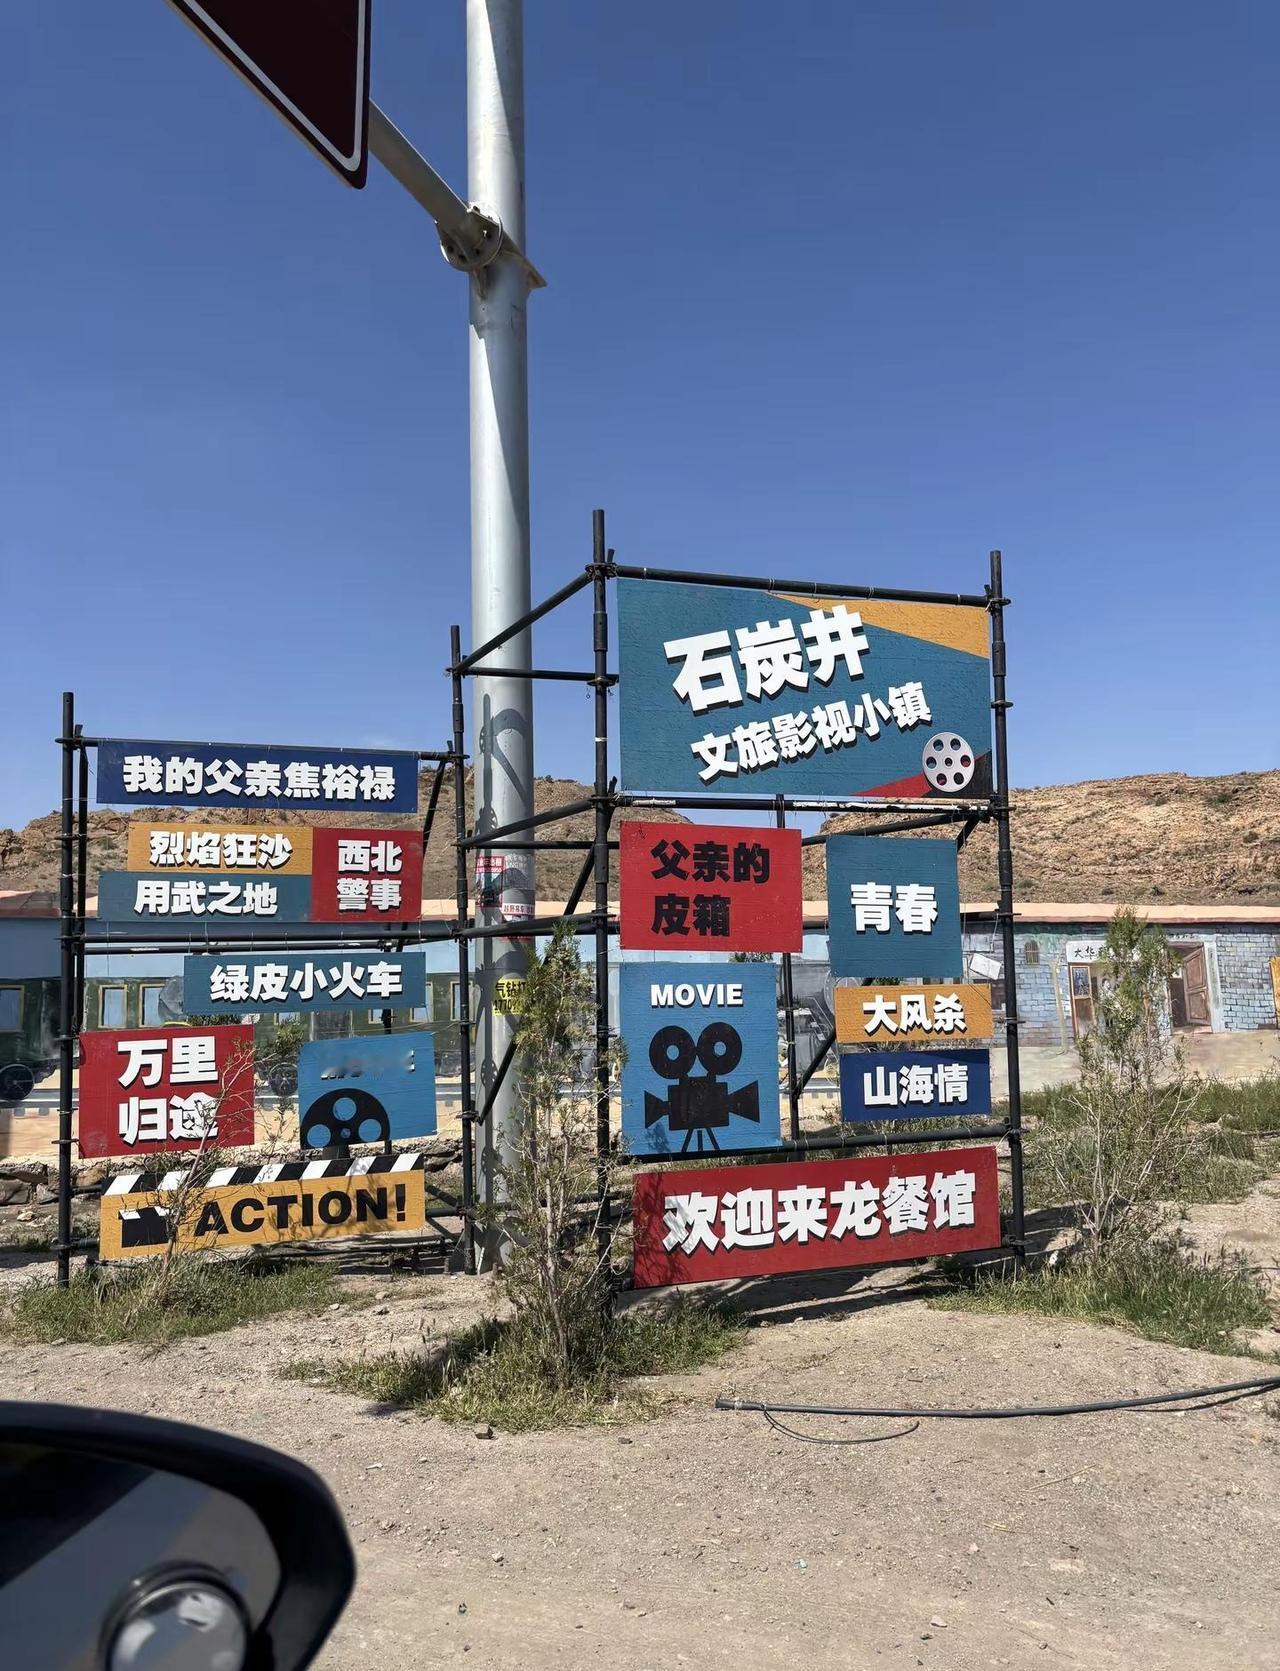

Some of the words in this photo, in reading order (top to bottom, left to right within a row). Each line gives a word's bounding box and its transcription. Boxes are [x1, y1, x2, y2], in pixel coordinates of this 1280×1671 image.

[663, 604, 870, 713] 石炭井
[690, 681, 933, 782] 文旅影视小镇
[123, 755, 396, 800] 我的父亲焦裕禄
[149, 830, 293, 868] 烈焰狂沙
[338, 839, 402, 872] 西北
[650, 838, 770, 884] 父亲的
[134, 880, 278, 915] 用武之地
[336, 877, 402, 910] 警事
[651, 893, 731, 937] 皮箱
[850, 882, 938, 932] 青春
[210, 961, 403, 1001] 绿皮小火车
[650, 983, 743, 1006] MOVIE
[862, 993, 967, 1033] 大风杀
[117, 1036, 219, 1087] 万里
[863, 1063, 969, 1106] 山海情
[118, 1091, 219, 1145] 归途
[194, 1184, 406, 1238] ACTION!
[662, 1169, 976, 1255] 欢迎来龙餐馆
